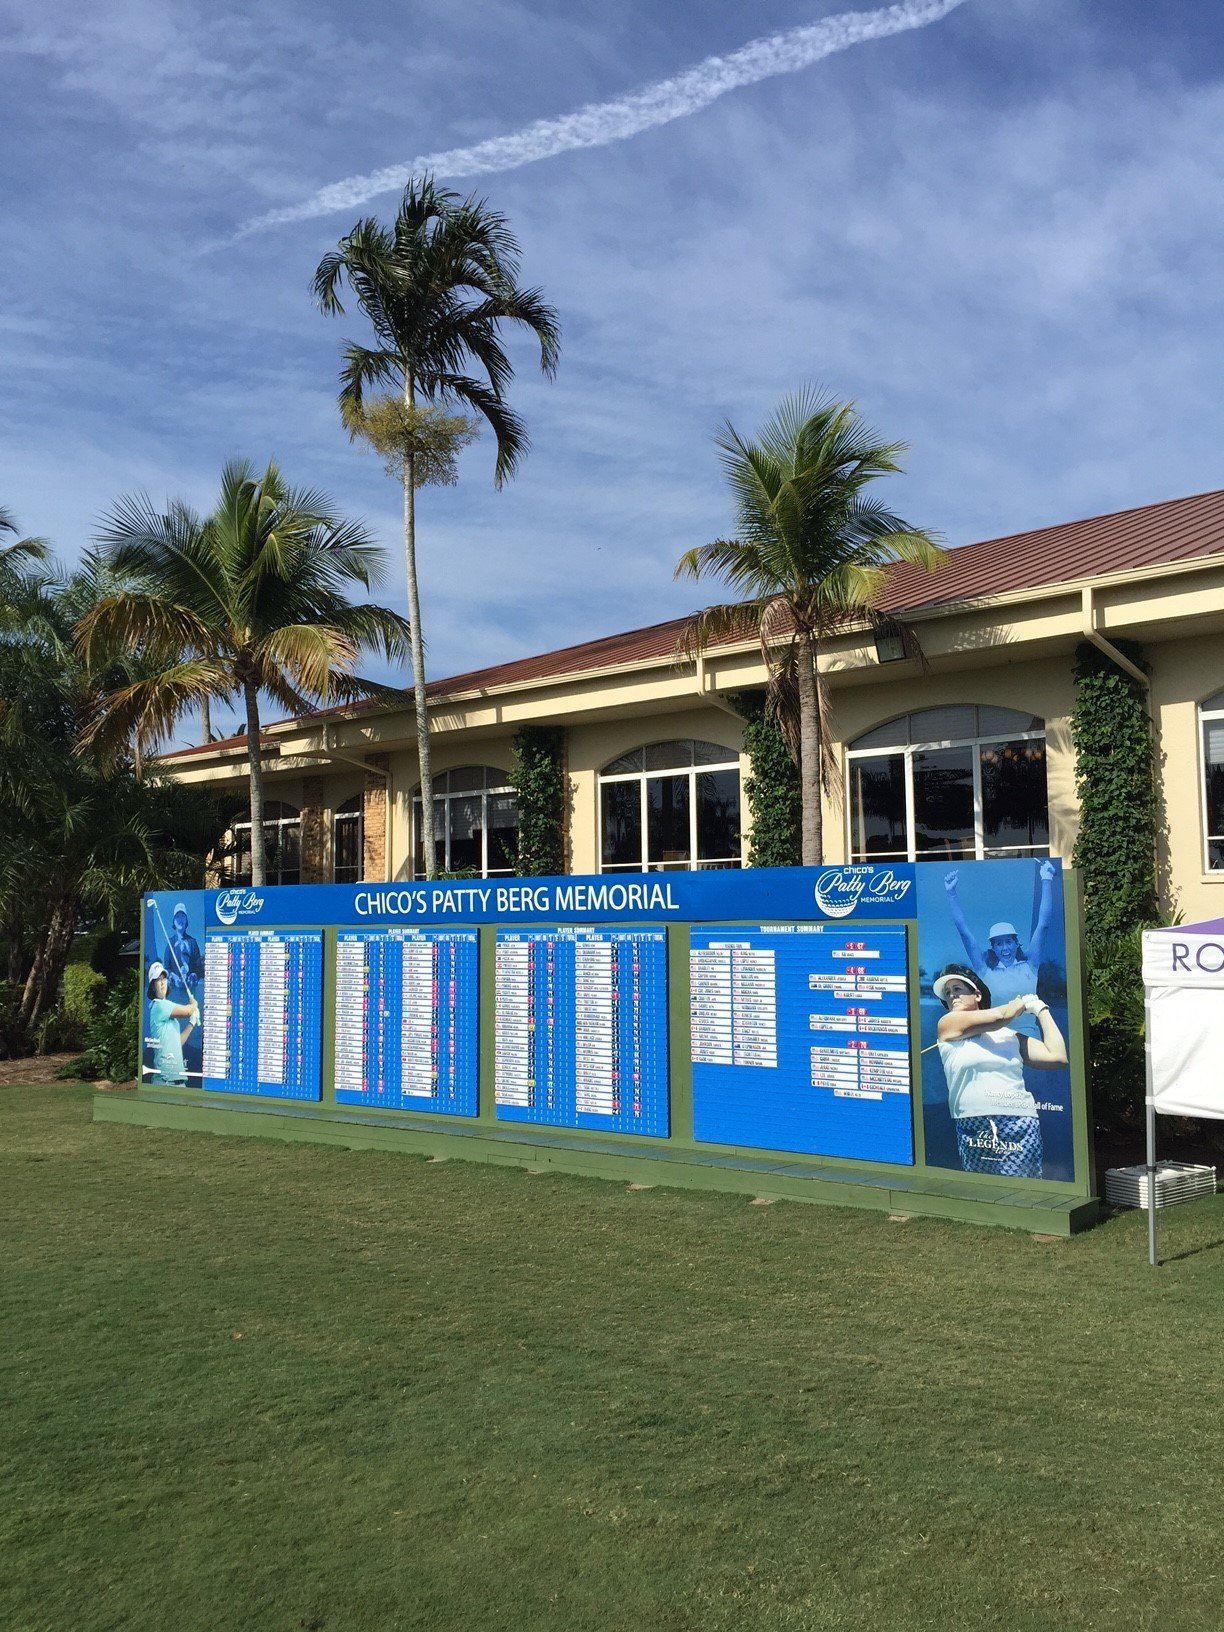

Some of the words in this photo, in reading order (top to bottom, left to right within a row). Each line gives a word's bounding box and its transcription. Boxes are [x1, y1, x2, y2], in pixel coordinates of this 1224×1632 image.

[843, 866, 874, 875] chico's
[818, 872, 866, 900] Patty
[868, 870, 912, 900] Berg
[354, 890, 428, 915] CHICO'S
[432, 888, 492, 914] PATTY
[496, 886, 550, 913] BERG
[555, 883, 680, 911] MEMORIAL
[760, 925, 795, 933] TOURNAMENT
[796, 925, 824, 933] SUMMARY
[1172, 943, 1224, 973] RO
[1041, 1102, 1049, 1110] of
[1048, 1102, 1064, 1112] Fame
[968, 1137, 1024, 1152] LEGENDS
